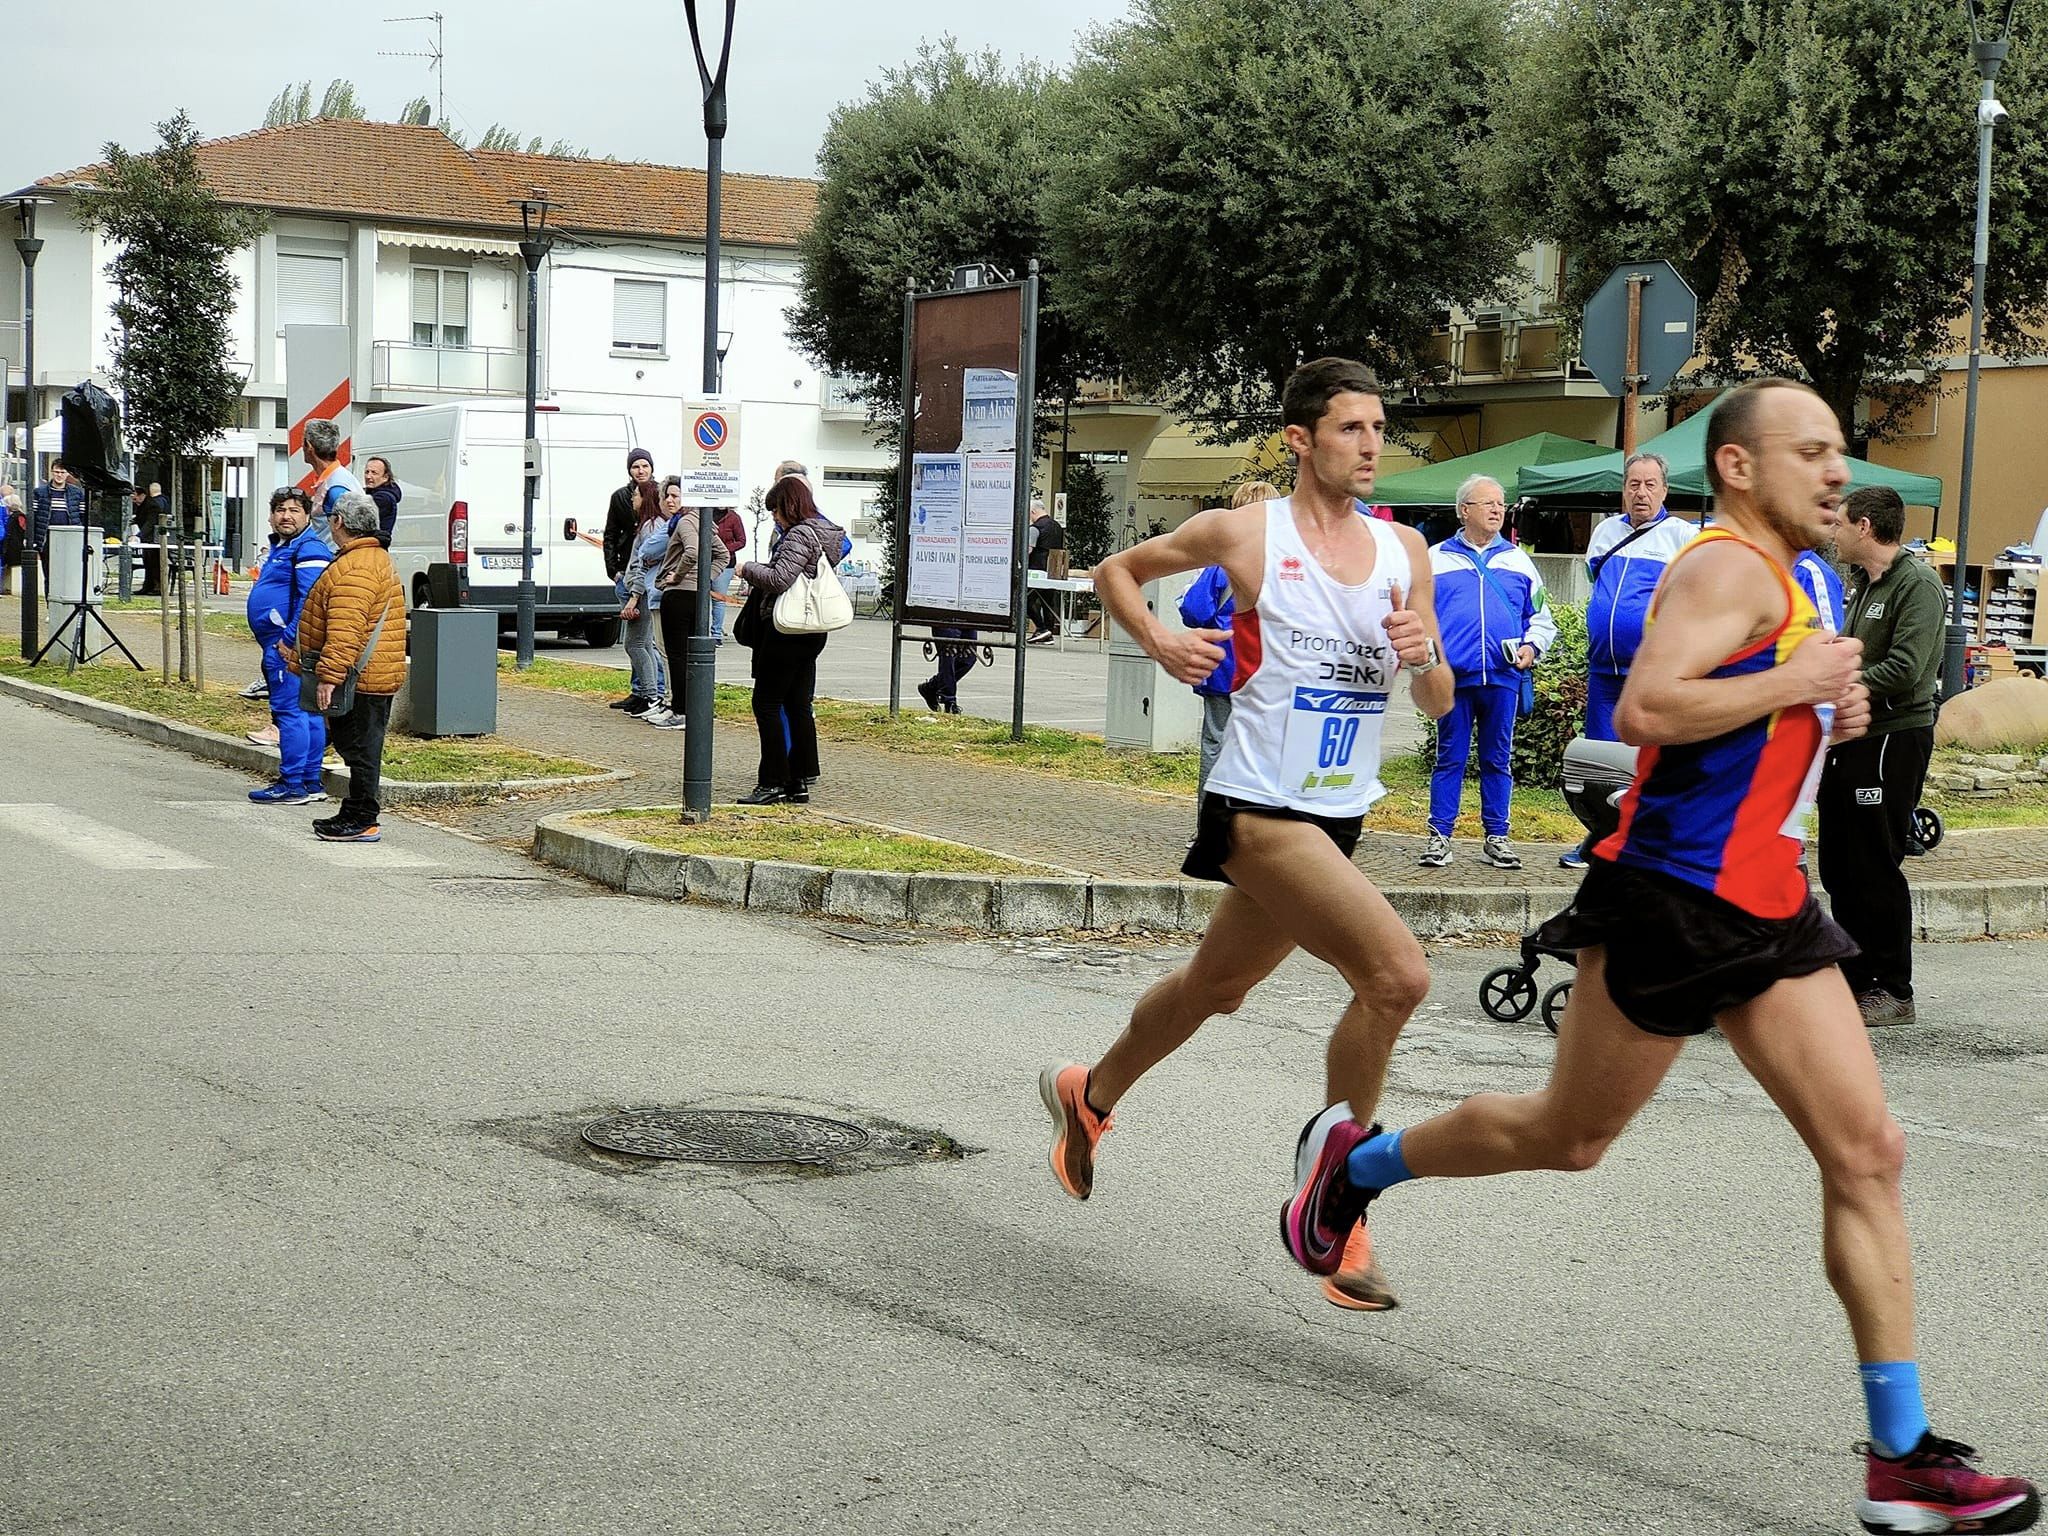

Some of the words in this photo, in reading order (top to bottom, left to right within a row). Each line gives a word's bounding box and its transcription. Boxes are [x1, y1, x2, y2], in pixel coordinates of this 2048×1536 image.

[966, 400, 986, 420] Ivan
[988, 399, 1014, 420] Alvisi
[971, 461, 1013, 469] RINGRAZIAMENTO
[989, 479, 1012, 490] NATALIA
[916, 535, 956, 544] RINGRAZIAMENTO
[967, 537, 1008, 545] RINGRAZIAMENTO
[487, 557, 499, 567] EA
[915, 551, 938, 562] ALVISI
[939, 552, 956, 564] IVAN
[965, 555, 983, 564] TURCHI
[984, 555, 1009, 565] ANSELMO
[1291, 630, 1386, 660] Promotec
[1318, 716, 1360, 769] 60
[1857, 790, 1880, 800] EA7
